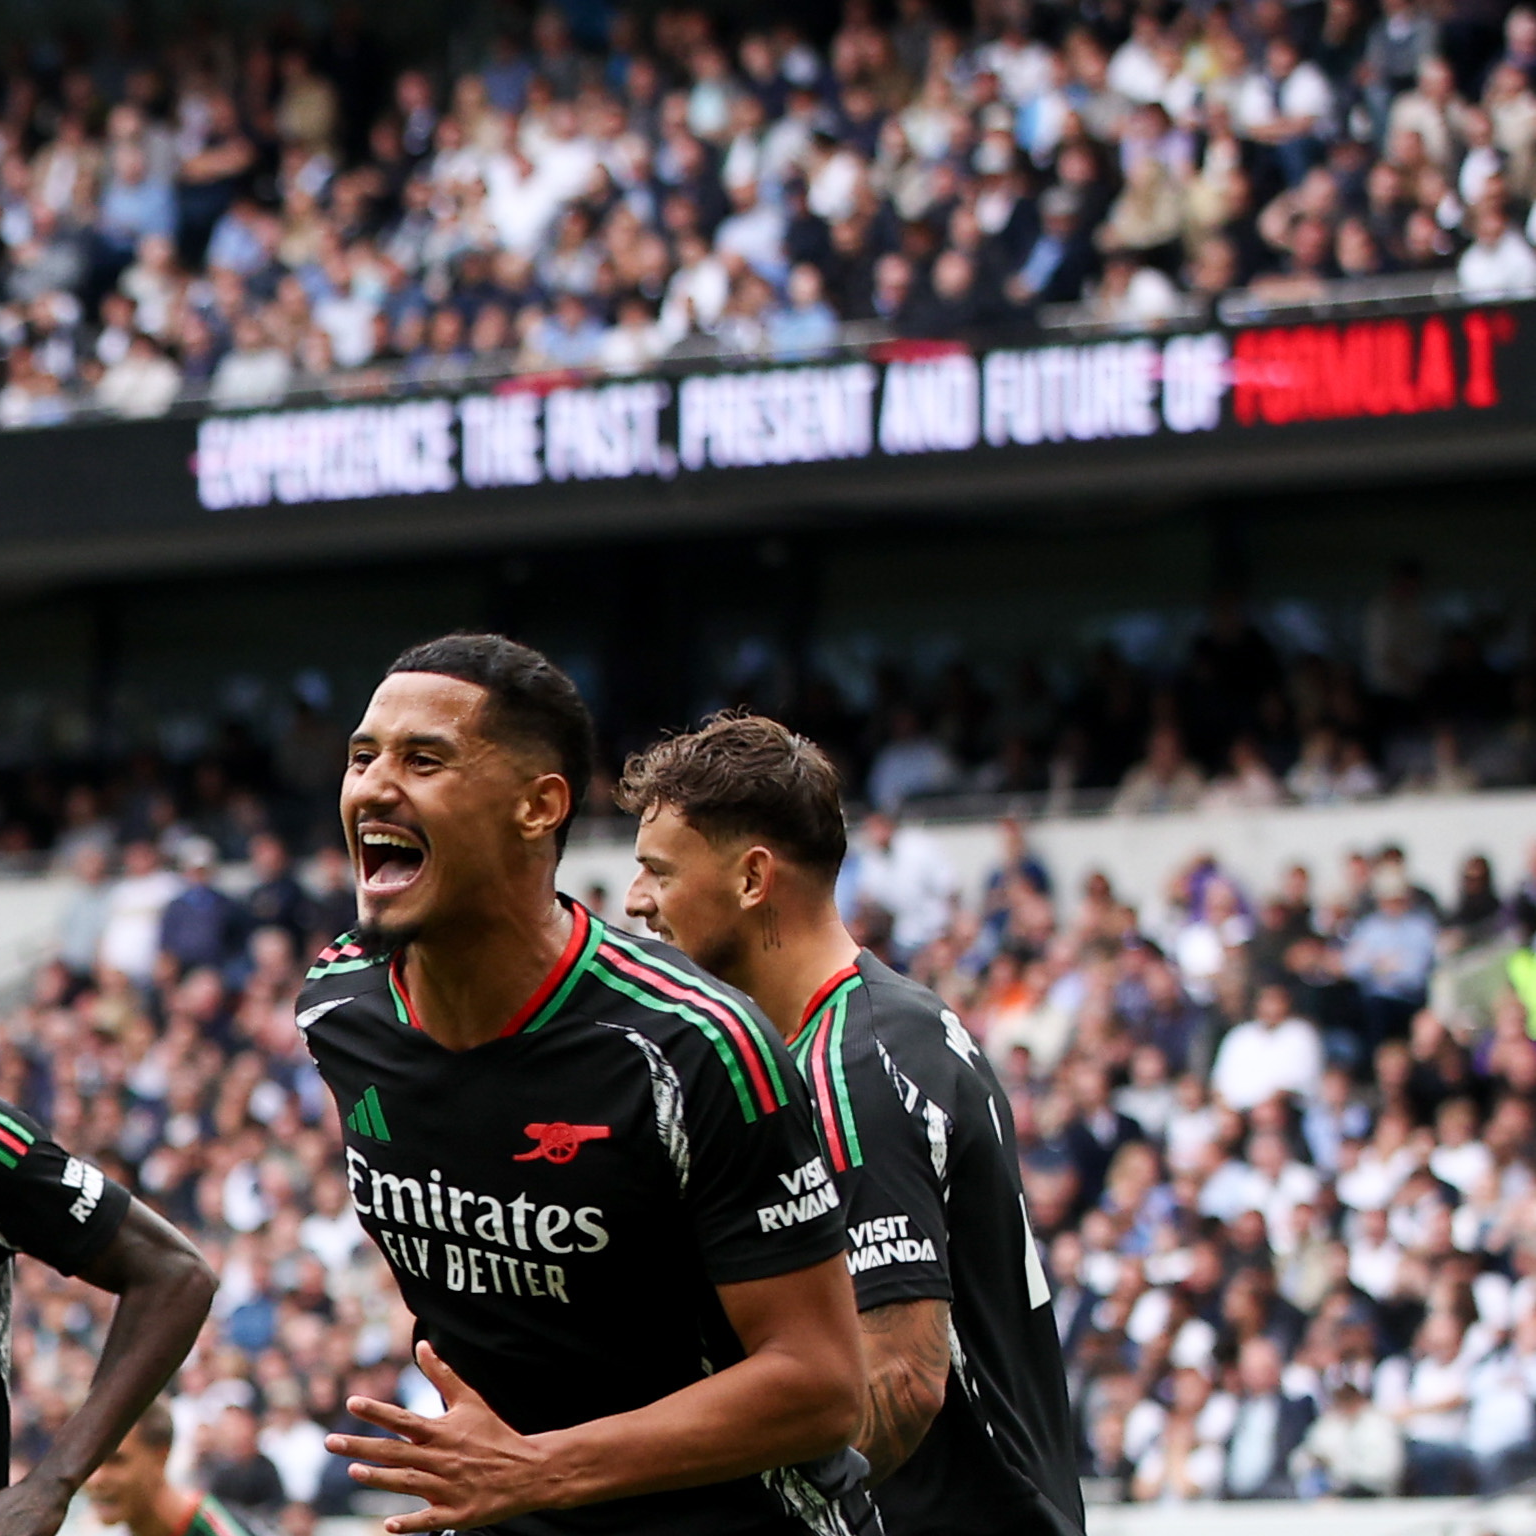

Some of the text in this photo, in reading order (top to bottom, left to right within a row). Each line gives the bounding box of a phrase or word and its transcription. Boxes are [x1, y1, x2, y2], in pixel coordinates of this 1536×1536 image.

[462, 391, 544, 489] THE
[679, 362, 877, 471] PRESENT
[878, 353, 980, 456] AND
[983, 338, 1160, 448] FUTURE
[1163, 331, 1227, 434] OF
[345, 1145, 610, 1254] Emirates
[757, 1180, 840, 1233] RWAN
[847, 1215, 910, 1248] VISIT
[381, 1229, 572, 1304] FLY BETTER
[844, 1238, 938, 1276] WANDA
